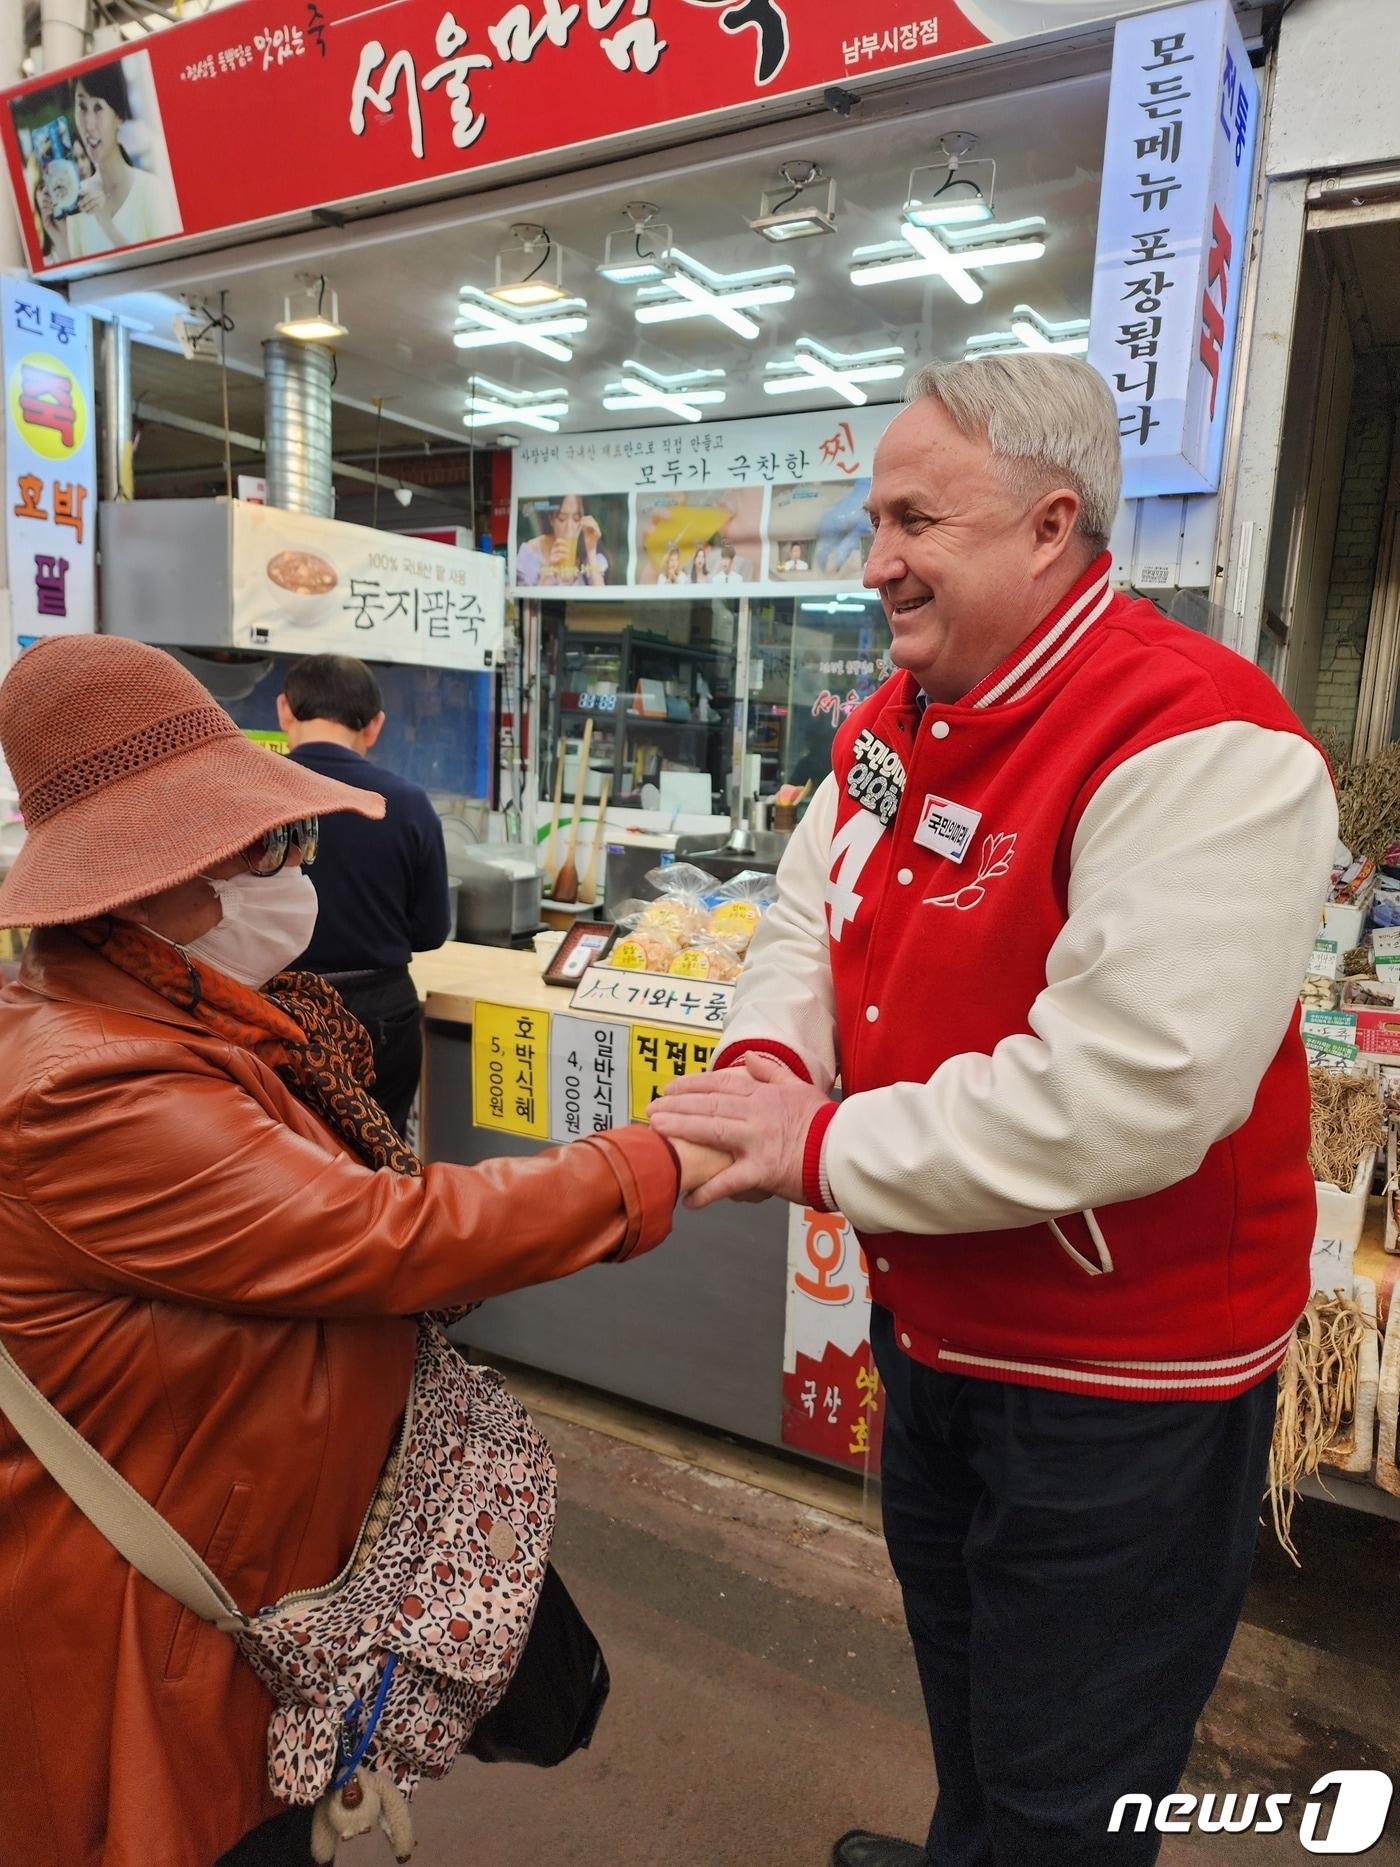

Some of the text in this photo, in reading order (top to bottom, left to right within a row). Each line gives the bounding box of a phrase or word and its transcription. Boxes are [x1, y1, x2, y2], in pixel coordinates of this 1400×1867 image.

[253, 25, 306, 71] 맛있는
[841, 18, 940, 64] 남부시장점
[1218, 48, 1249, 168] 전통
[14, 299, 77, 344] 전통
[1112, 228, 1176, 446] 포장됩니다
[19, 362, 77, 448] 죽
[635, 421, 861, 487] 모두가 극찬한 찐
[690, 433, 724, 454] 만들고
[14, 473, 87, 545] 호박
[368, 552, 398, 572] 100%
[402, 557, 433, 580] 국내산
[449, 566, 467, 586] 사용
[343, 577, 487, 647] 동지팥죽
[847, 762, 899, 825] 인요한
[489, 1036, 505, 1118] 5,000원
[514, 1016, 536, 1125] 호박식혜
[564, 1050, 584, 1135] 4,000원
[592, 1030, 614, 1133] 일반식혜
[801, 1379, 842, 1425] 국산
